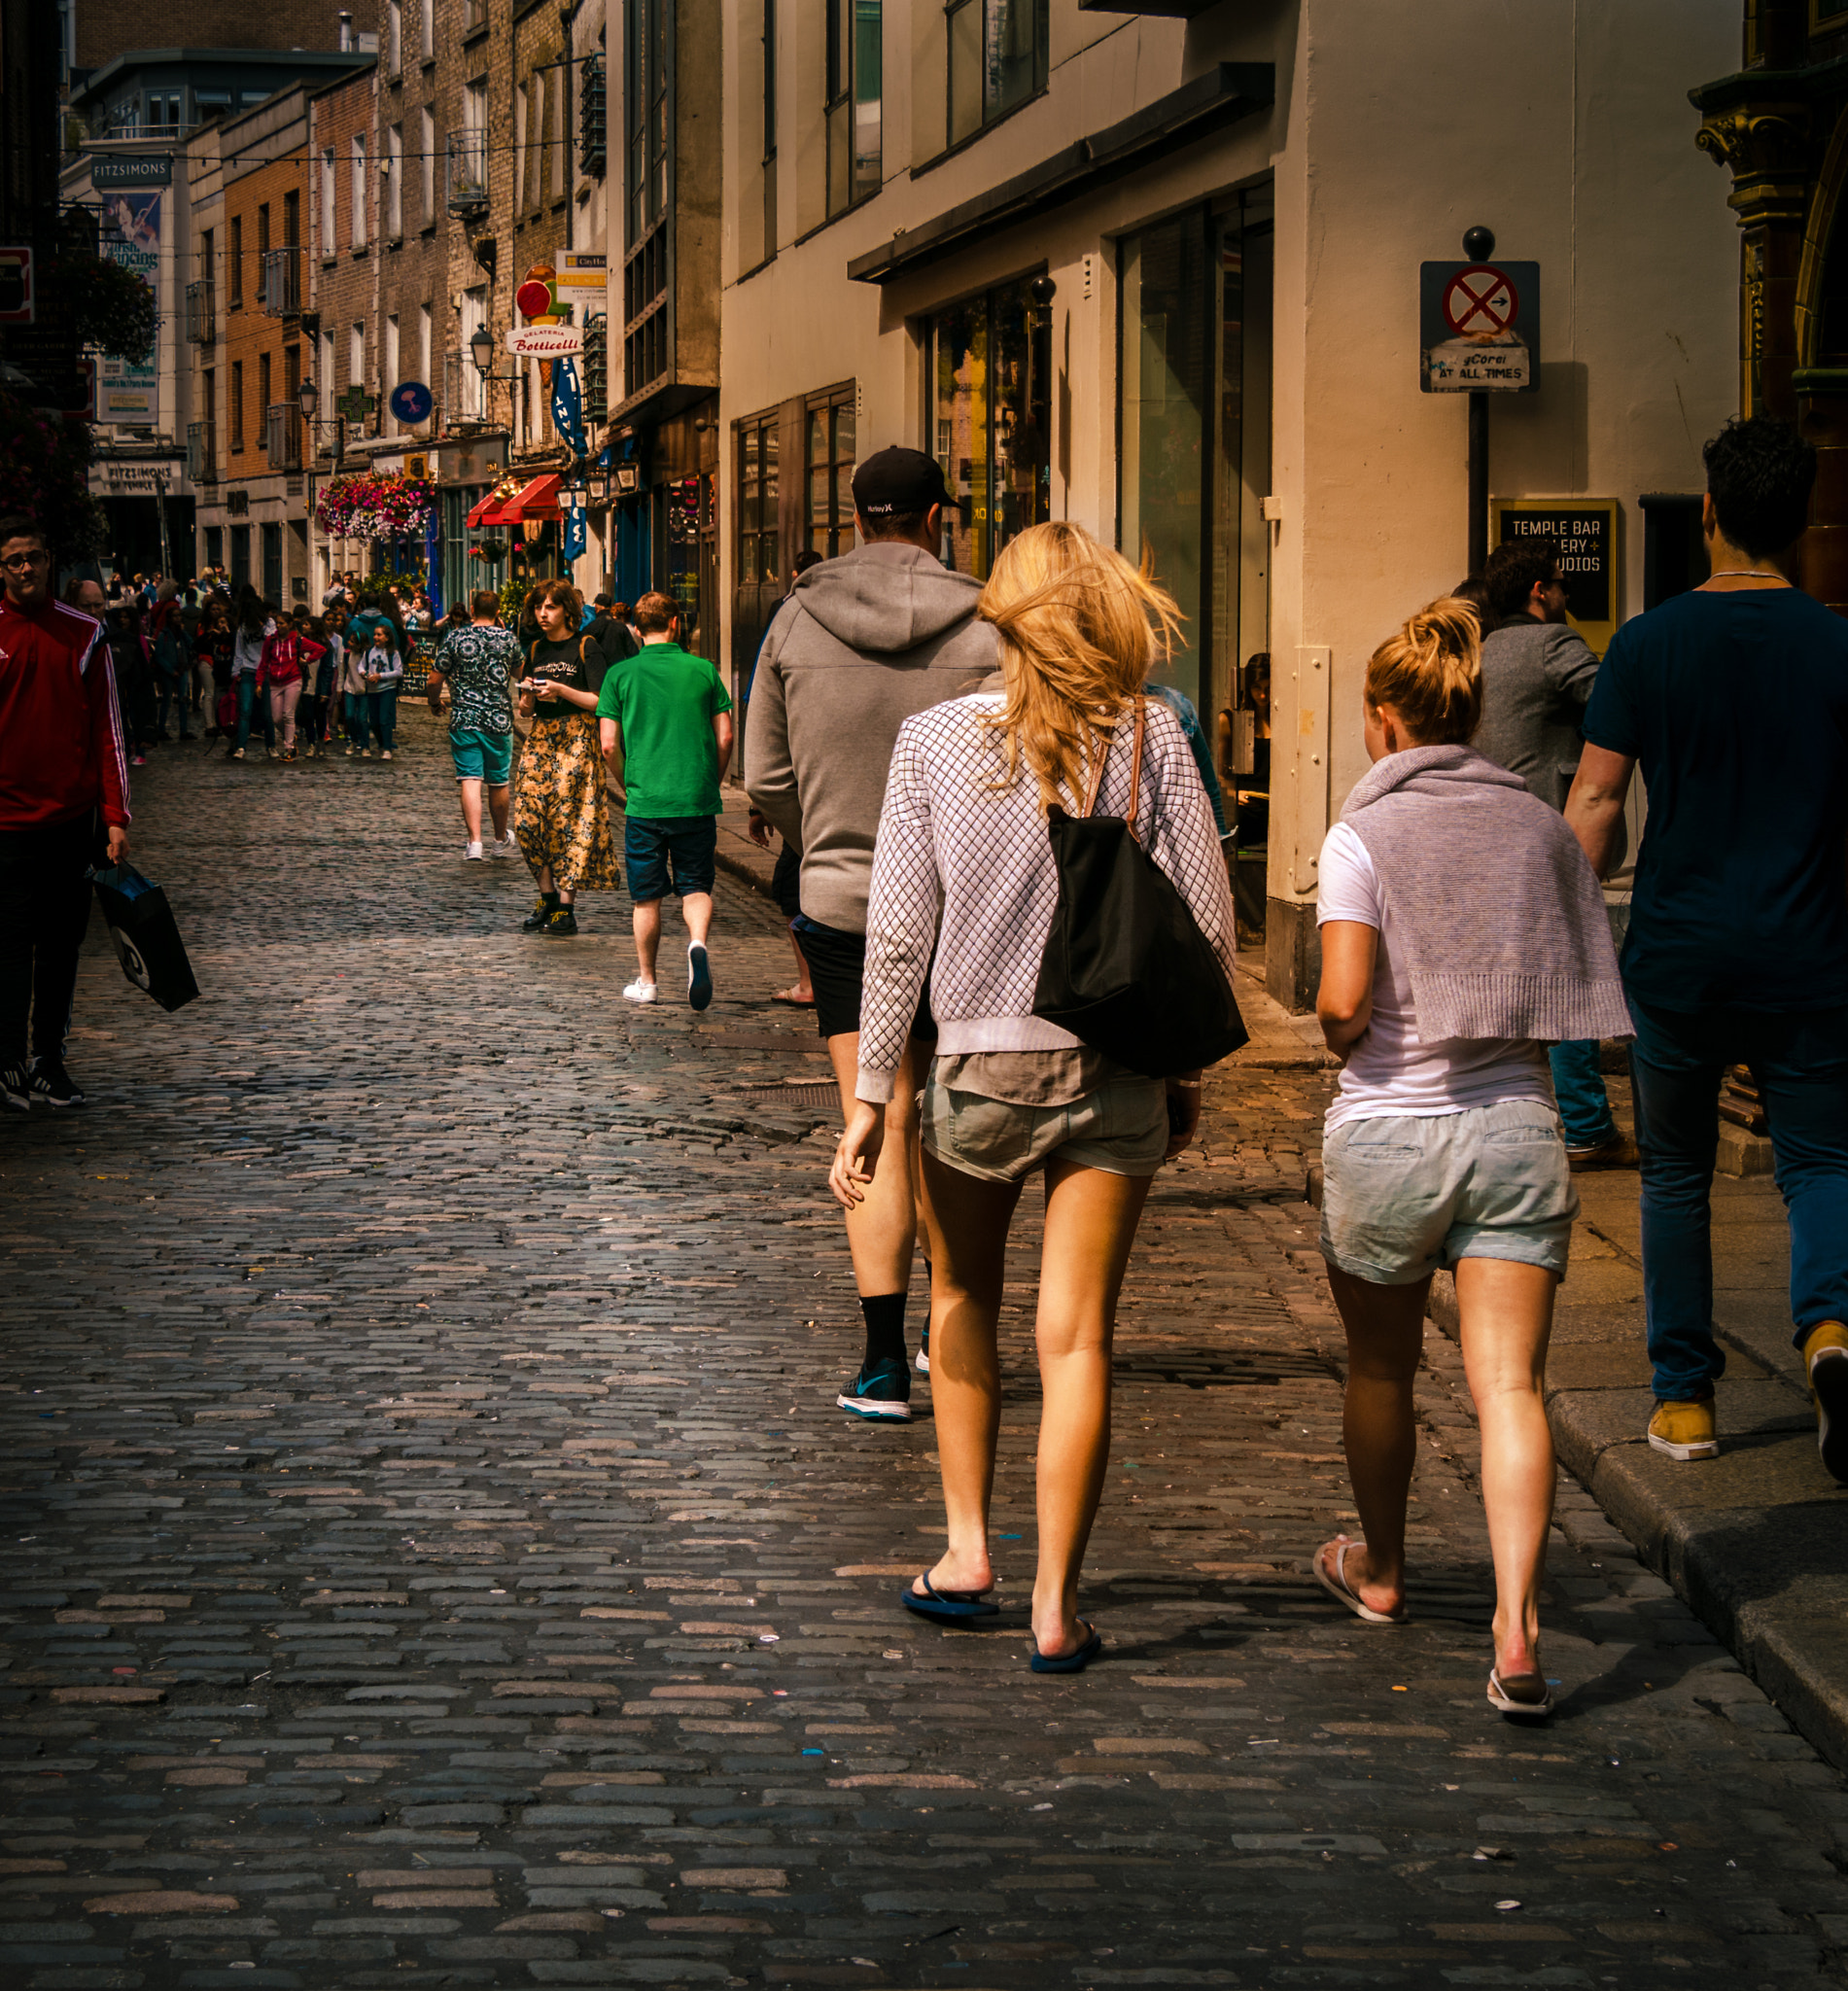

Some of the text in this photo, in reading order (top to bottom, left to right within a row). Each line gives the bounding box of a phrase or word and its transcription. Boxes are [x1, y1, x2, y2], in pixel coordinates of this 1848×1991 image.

[94, 162, 166, 177] FITZSIMONS
[512, 339, 578, 351] Botticelli
[1440, 368, 1521, 378] AT ALL TIMES
[109, 468, 171, 478] FITZSIMONS
[1512, 520, 1600, 536] TEMPLE BAR
[1556, 557, 1600, 572] UDIOS
